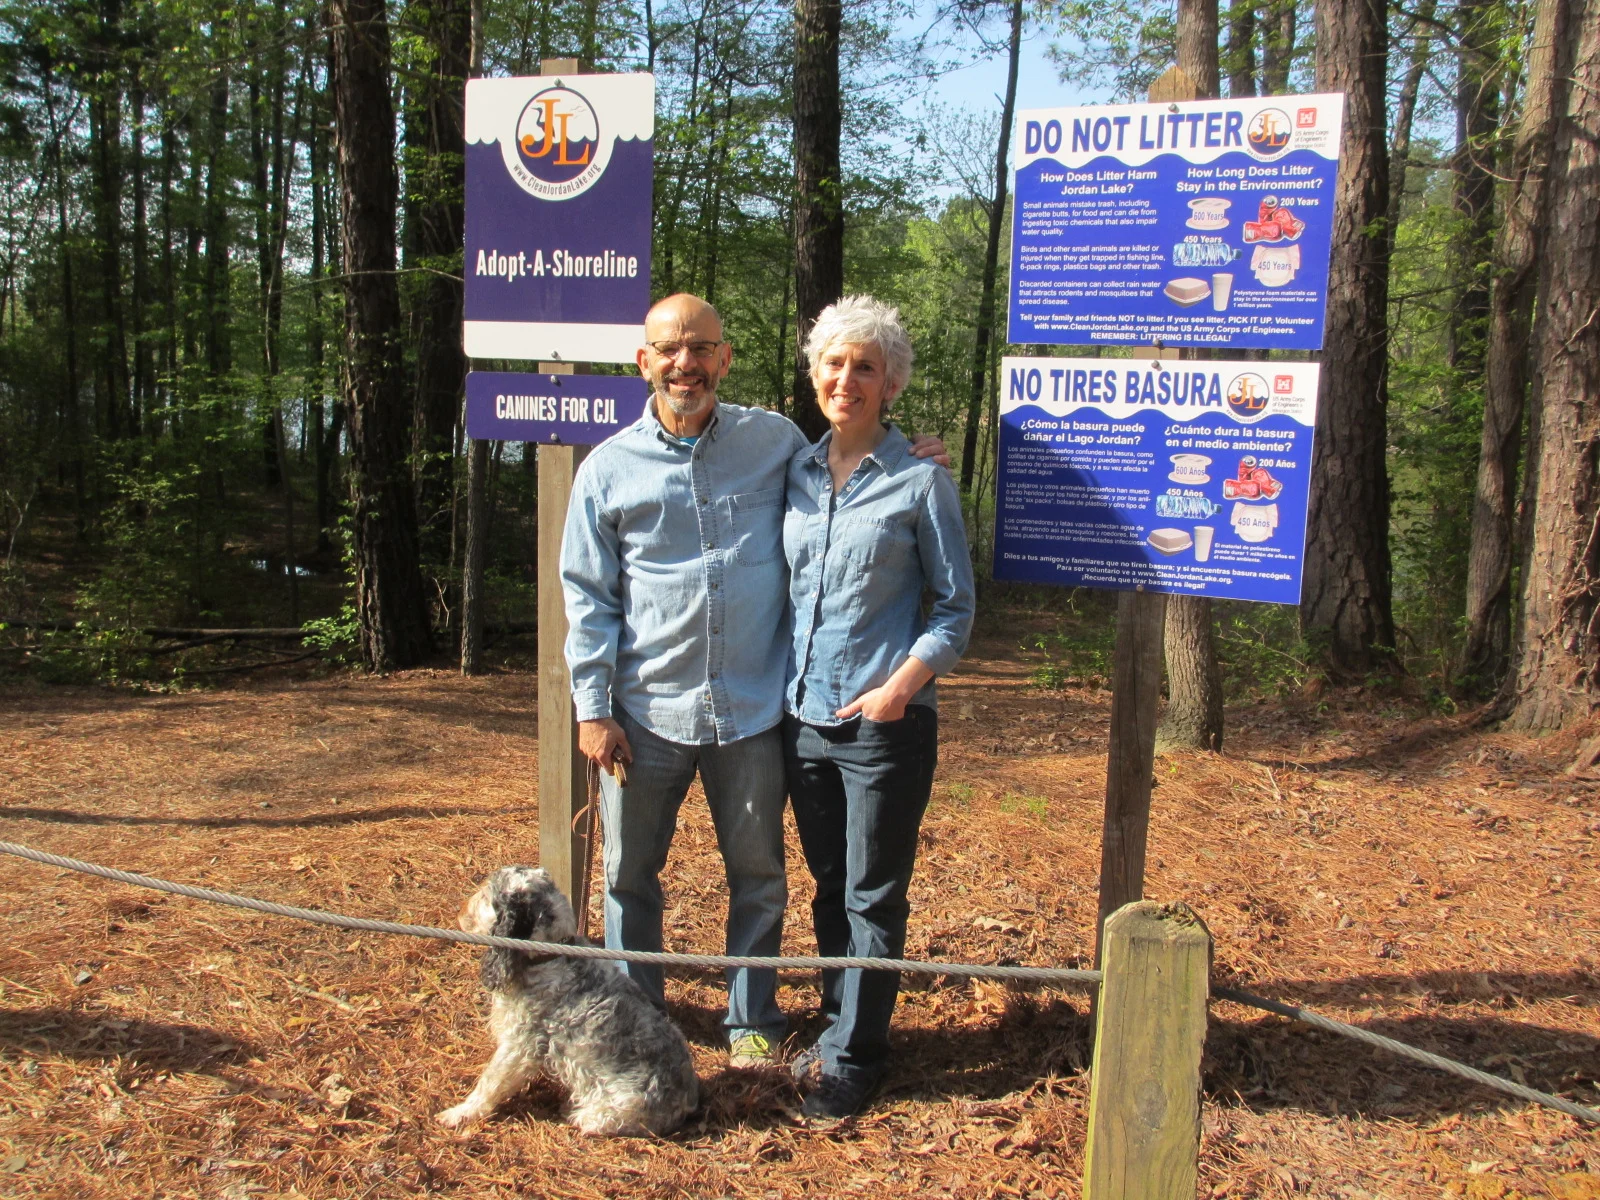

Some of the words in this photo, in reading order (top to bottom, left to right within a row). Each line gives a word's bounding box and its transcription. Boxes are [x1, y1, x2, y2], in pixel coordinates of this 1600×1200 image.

[1025, 118, 1062, 154] DO
[1072, 115, 1130, 152] NOT
[1140, 110, 1243, 150] LITTER
[1041, 173, 1064, 182] How
[1067, 172, 1093, 182] Does
[1097, 171, 1125, 181] Litter
[1128, 170, 1157, 180] Harm
[1188, 168, 1213, 178] How
[1216, 167, 1245, 179] Long
[1249, 166, 1278, 176] Does
[1282, 165, 1314, 175] Litter
[513, 163, 601, 195] www.CleanJordanLake.org
[1061, 185, 1098, 195] Jordan
[1101, 184, 1134, 194] Lake?
[1176, 182, 1202, 193] Stay
[1205, 182, 1215, 191] in
[1218, 181, 1236, 190] the
[1240, 179, 1323, 190] Environment?
[1119, 200, 1150, 208] including
[1194, 212, 1205, 220] 600
[1207, 212, 1224, 220] Years
[476, 250, 637, 282] Adopt-A-Shoreline
[1273, 262, 1291, 270] Years
[1052, 314, 1073, 322] family
[1206, 316, 1226, 324] litter,
[1051, 323, 1148, 332] www.CleanJordanLake.org
[1194, 325, 1215, 333] Army
[1216, 325, 1240, 334] Corps
[1253, 326, 1296, 334] Engineers.
[1010, 368, 1041, 401] NO
[1050, 369, 1117, 403] TIRES
[1125, 370, 1222, 407] BASURA
[496, 394, 556, 421] CANINES
[561, 398, 589, 422] FOR
[593, 399, 618, 424] CJL
[1021, 419, 1058, 431] ¿Cómo
[1061, 420, 1070, 430] la
[1073, 421, 1109, 431] basura
[1112, 422, 1145, 434] puede
[1164, 425, 1211, 438] ¿Cuánto
[1214, 427, 1240, 436] dura
[1243, 427, 1253, 437] la
[1256, 428, 1295, 438] basura
[1024, 431, 1053, 441] dañar
[1056, 432, 1065, 442] el
[1068, 433, 1094, 444] Lago
[1097, 434, 1141, 444] Jordan?
[1182, 438, 1192, 447] el
[1195, 439, 1230, 449] medio
[1232, 440, 1292, 451] ambiente?
[1276, 459, 1295, 468] Años
[1176, 467, 1187, 475] 600
[1189, 467, 1204, 475] Años
[1253, 519, 1270, 527] Años
[1040, 555, 1064, 564] amigos
[1071, 558, 1104, 566] familiares
[1190, 566, 1230, 575] encuentras
[1258, 572, 1292, 581] recógela.
[1086, 566, 1120, 574] voluntario
